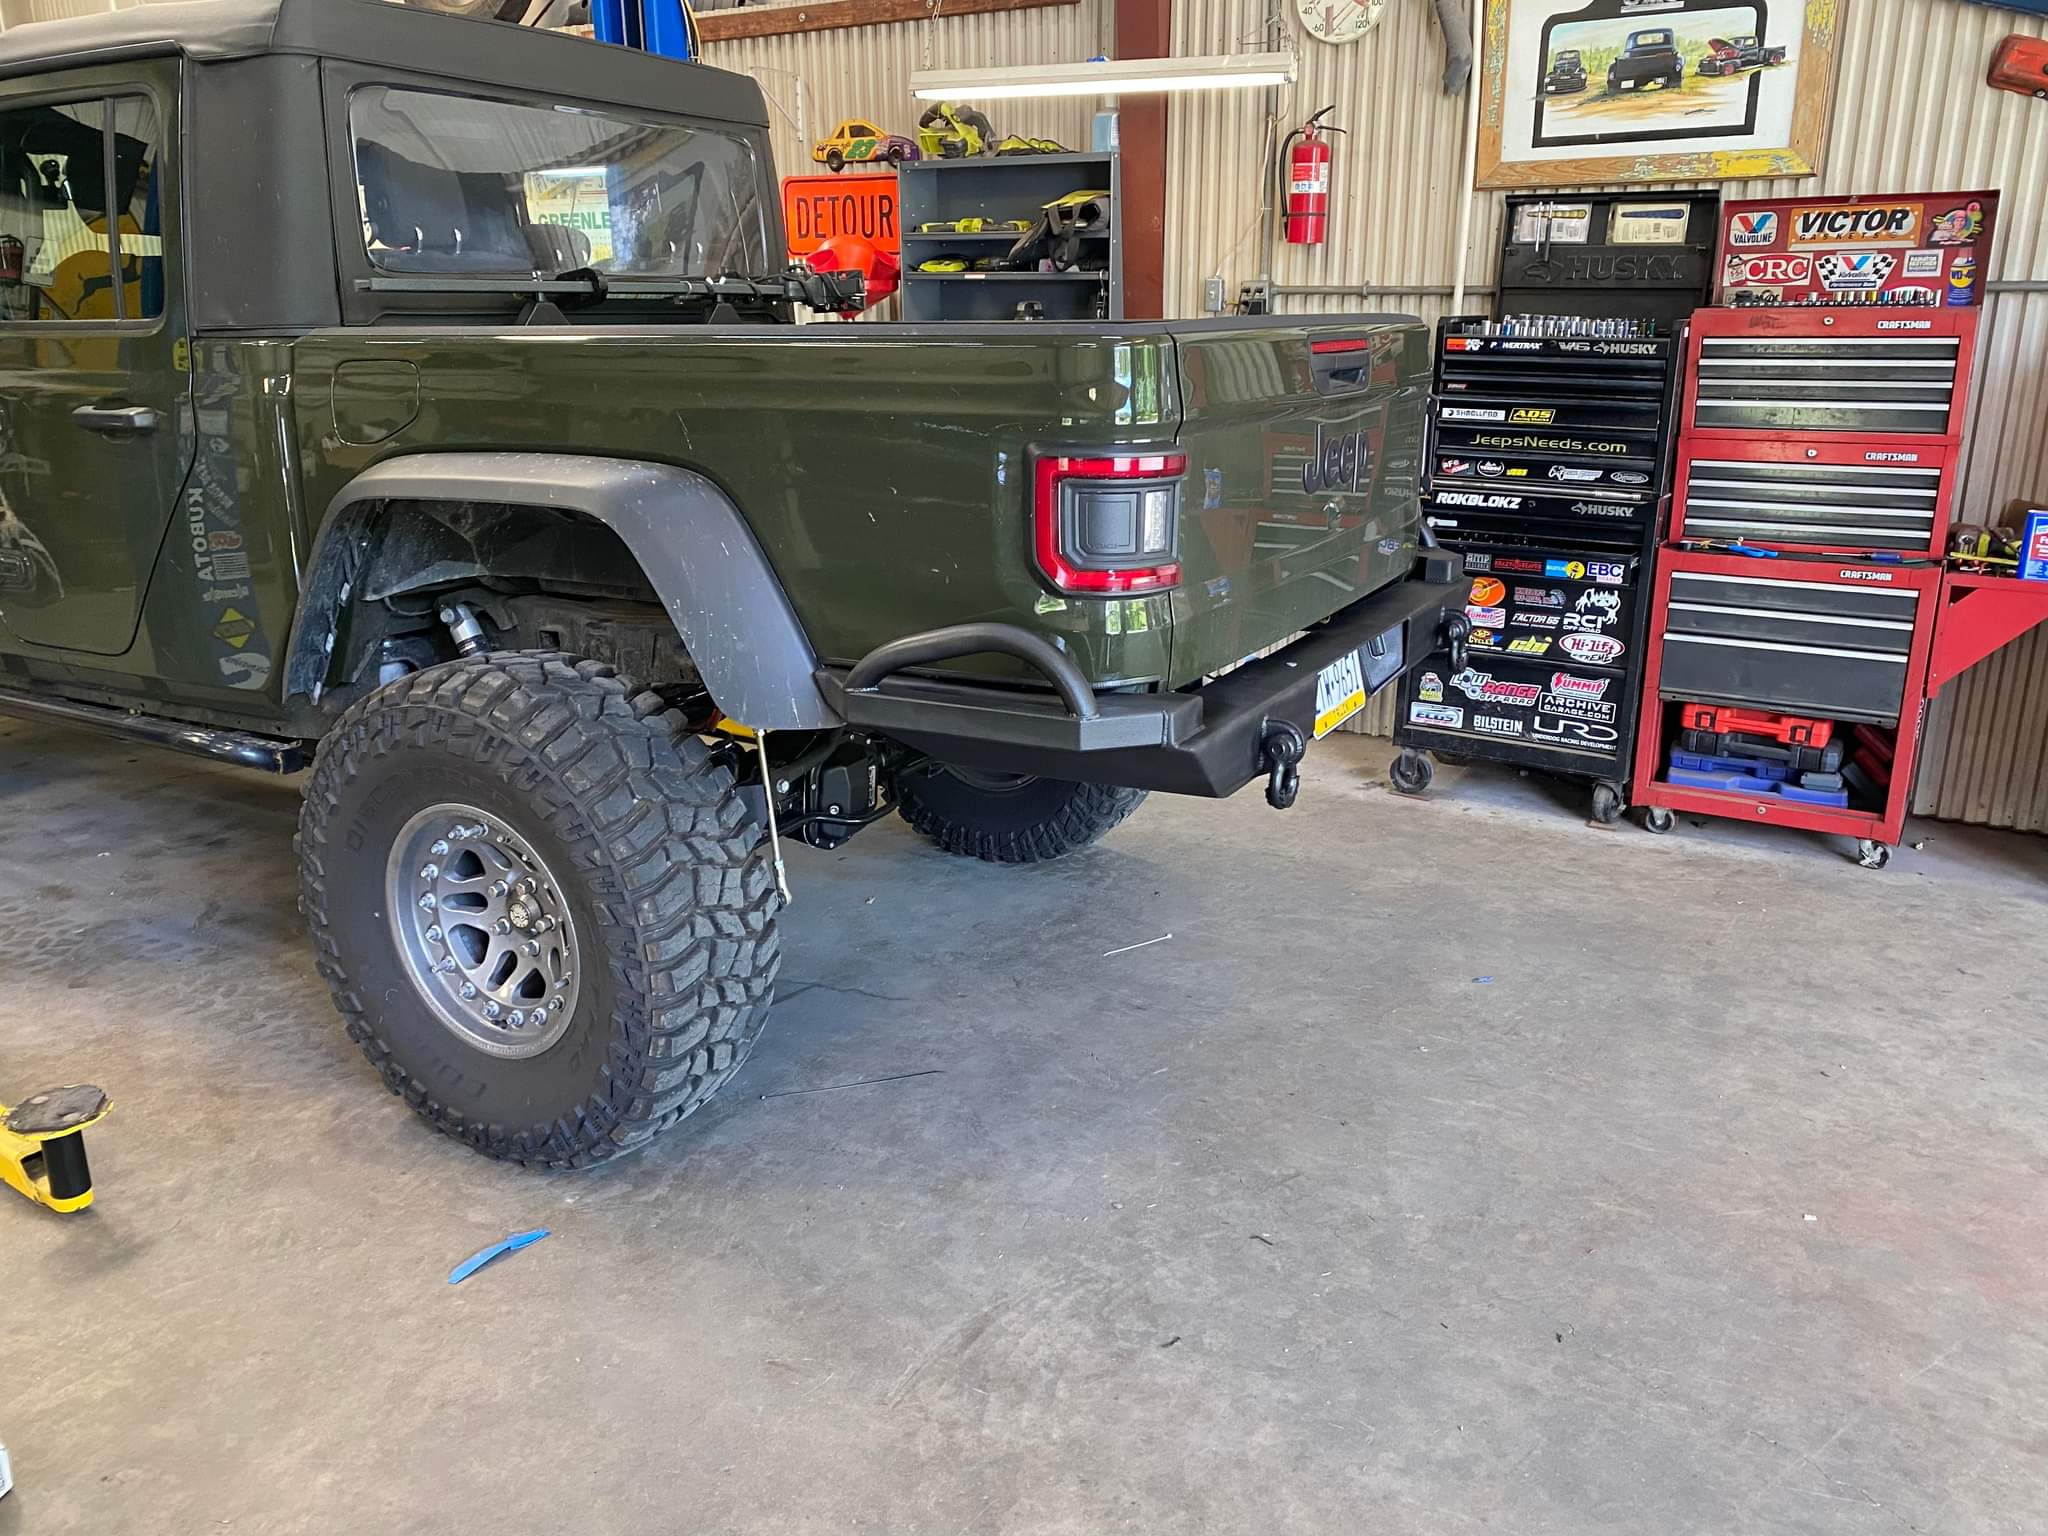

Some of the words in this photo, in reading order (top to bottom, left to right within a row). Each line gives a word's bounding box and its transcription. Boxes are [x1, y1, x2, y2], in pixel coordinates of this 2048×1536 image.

[1355, 20, 1368, 29] 120
[796, 195, 893, 238] DETOUR
[1799, 208, 1910, 235] VICTOR
[1734, 231, 1773, 244] VALVOLINE
[1799, 231, 1880, 241] GASKETS
[1566, 255, 1682, 280] HUSKY
[1746, 258, 1808, 280] CRC
[1837, 270, 1871, 278] Valvoline
[1877, 320, 1931, 329] CRAFTSMAN
[1610, 343, 1657, 355] HUSKY
[1513, 409, 1552, 418] ADS
[1470, 434, 1627, 453] JeepsNeeds.com
[1303, 423, 1369, 495] Jeep
[1865, 451, 1918, 462] CRAFTSMAN
[1436, 492, 1522, 509] ROKBLOKZ
[1588, 504, 1634, 517] HUSKY
[1588, 562, 1622, 577] EBC
[1840, 569, 1892, 581] CRAFTSMAN
[1512, 613, 1546, 624] FACTOR
[1563, 612, 1602, 629] RCI
[1481, 681, 1538, 699] RANGE
[1544, 695, 1611, 713] ARCHIVE
[1544, 704, 1610, 720] GARAGE.COM
[1473, 714, 1523, 733] BILSTEIN
